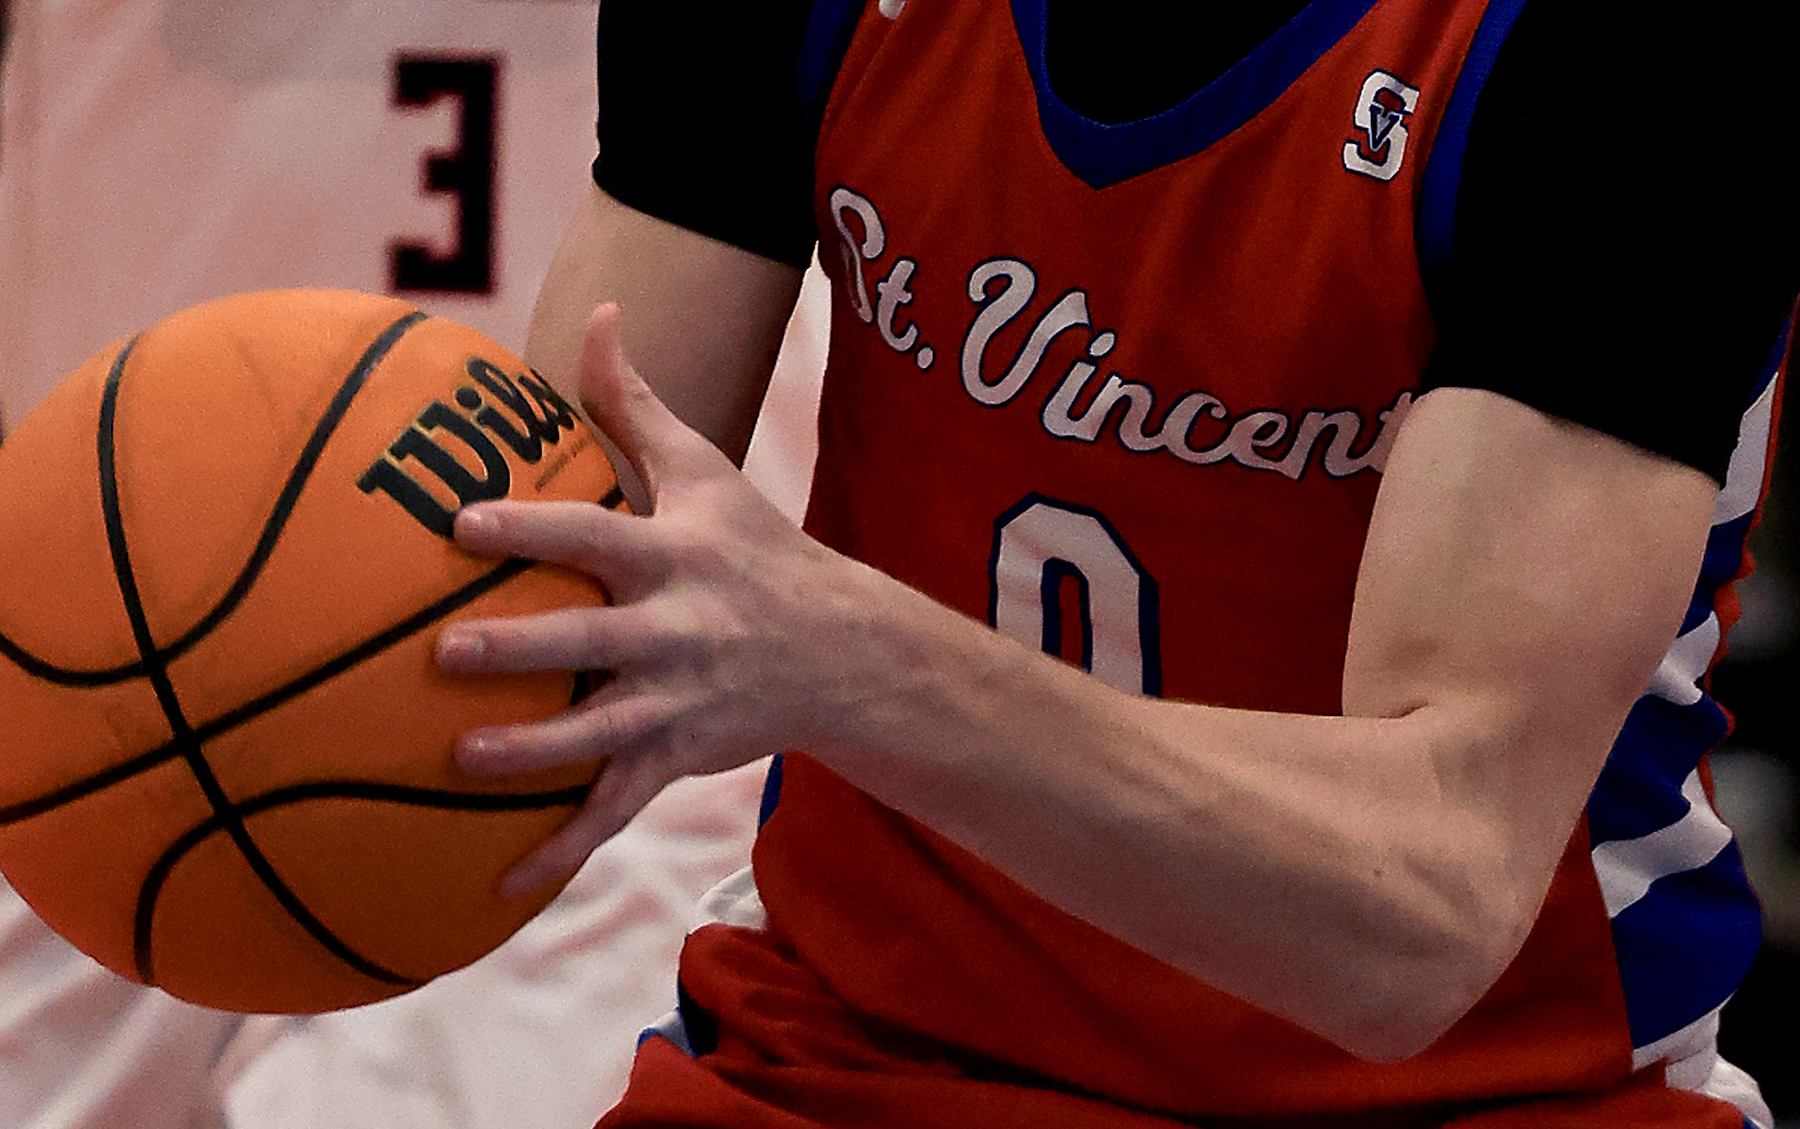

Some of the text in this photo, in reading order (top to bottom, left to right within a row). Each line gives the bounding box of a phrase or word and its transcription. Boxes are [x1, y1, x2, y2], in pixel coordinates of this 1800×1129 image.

[388, 49, 502, 295] 3
[828, 184, 1414, 481] St. Vincent
